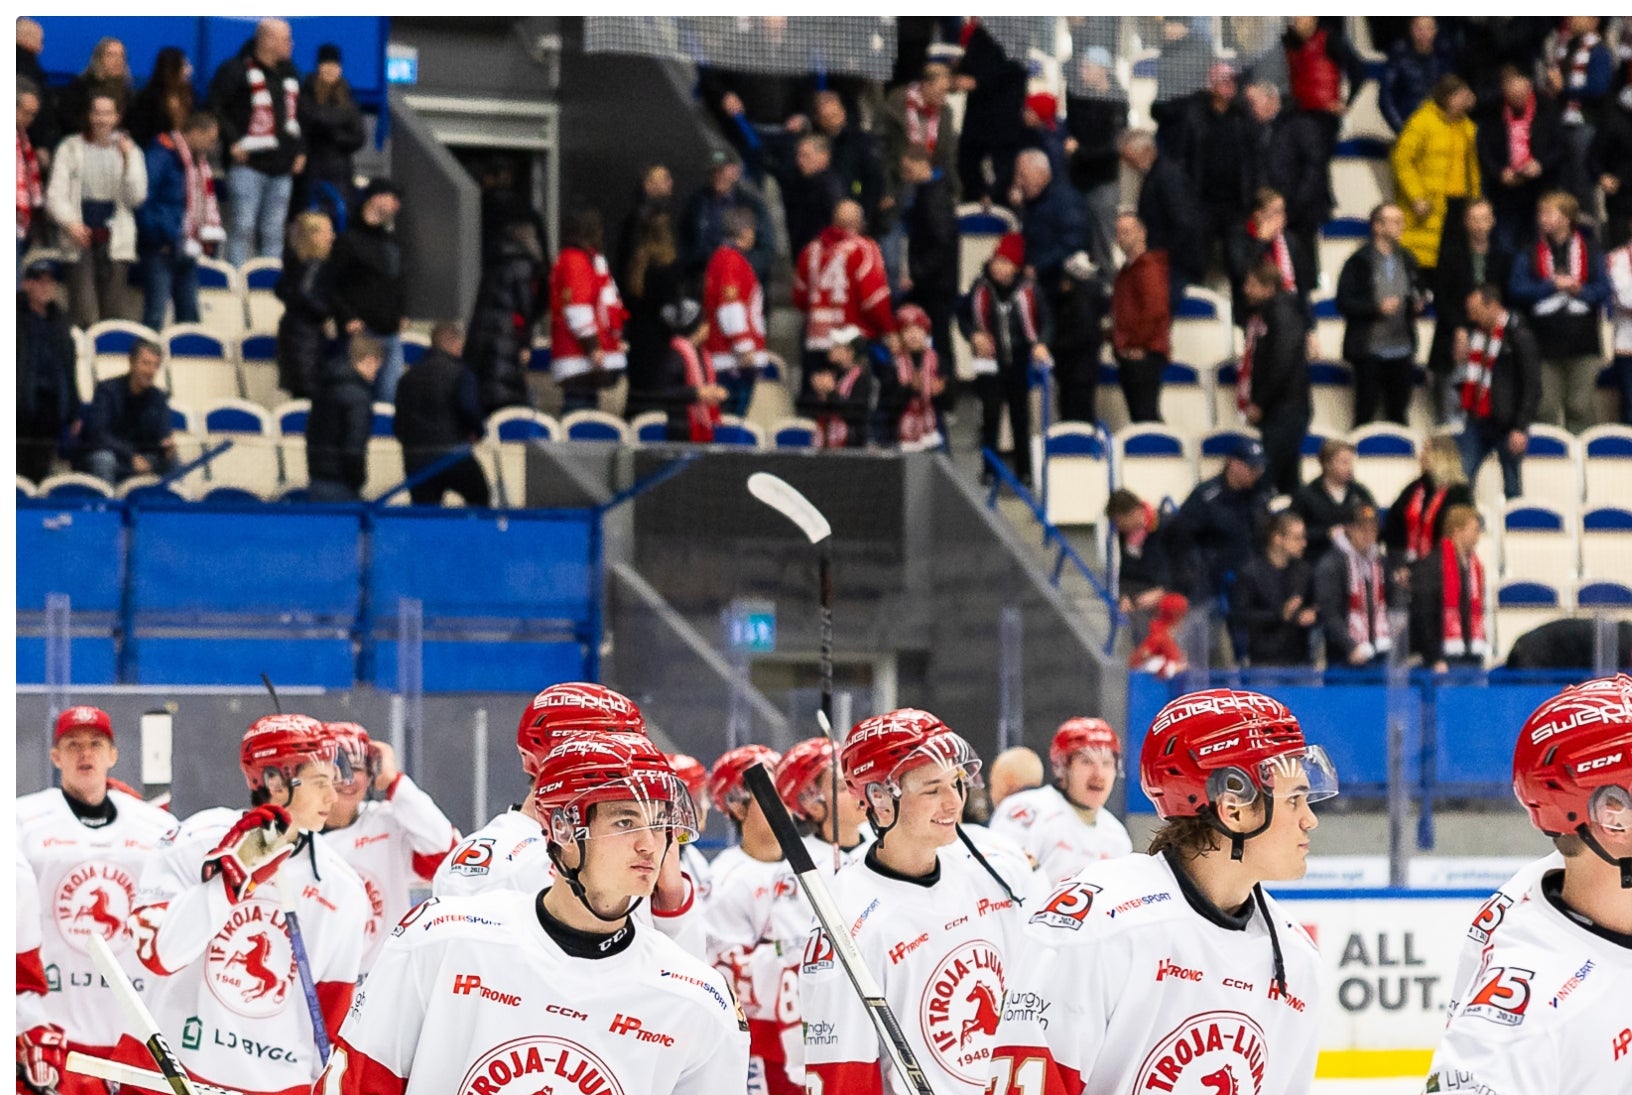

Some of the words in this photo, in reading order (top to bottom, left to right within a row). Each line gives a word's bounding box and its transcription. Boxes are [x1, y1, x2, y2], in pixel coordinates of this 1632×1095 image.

[1199, 737, 1240, 756] CCM
[852, 760, 875, 777] CCM
[1576, 752, 1623, 773] CCM
[538, 781, 564, 795] CCM
[1114, 891, 1173, 916] INTERSPORT
[944, 915, 969, 932] CCM
[209, 944, 226, 962] IF
[1338, 931, 1427, 967] ALL
[70, 972, 92, 987] LJ
[1222, 978, 1254, 992] CCM
[453, 974, 522, 1008] HPTRONIC
[1338, 975, 1447, 1012] OUT.
[545, 1004, 589, 1022] CCM
[214, 1028, 238, 1048] LJ
[932, 1029, 958, 1053] IF
[957, 1047, 990, 1068] 1948
